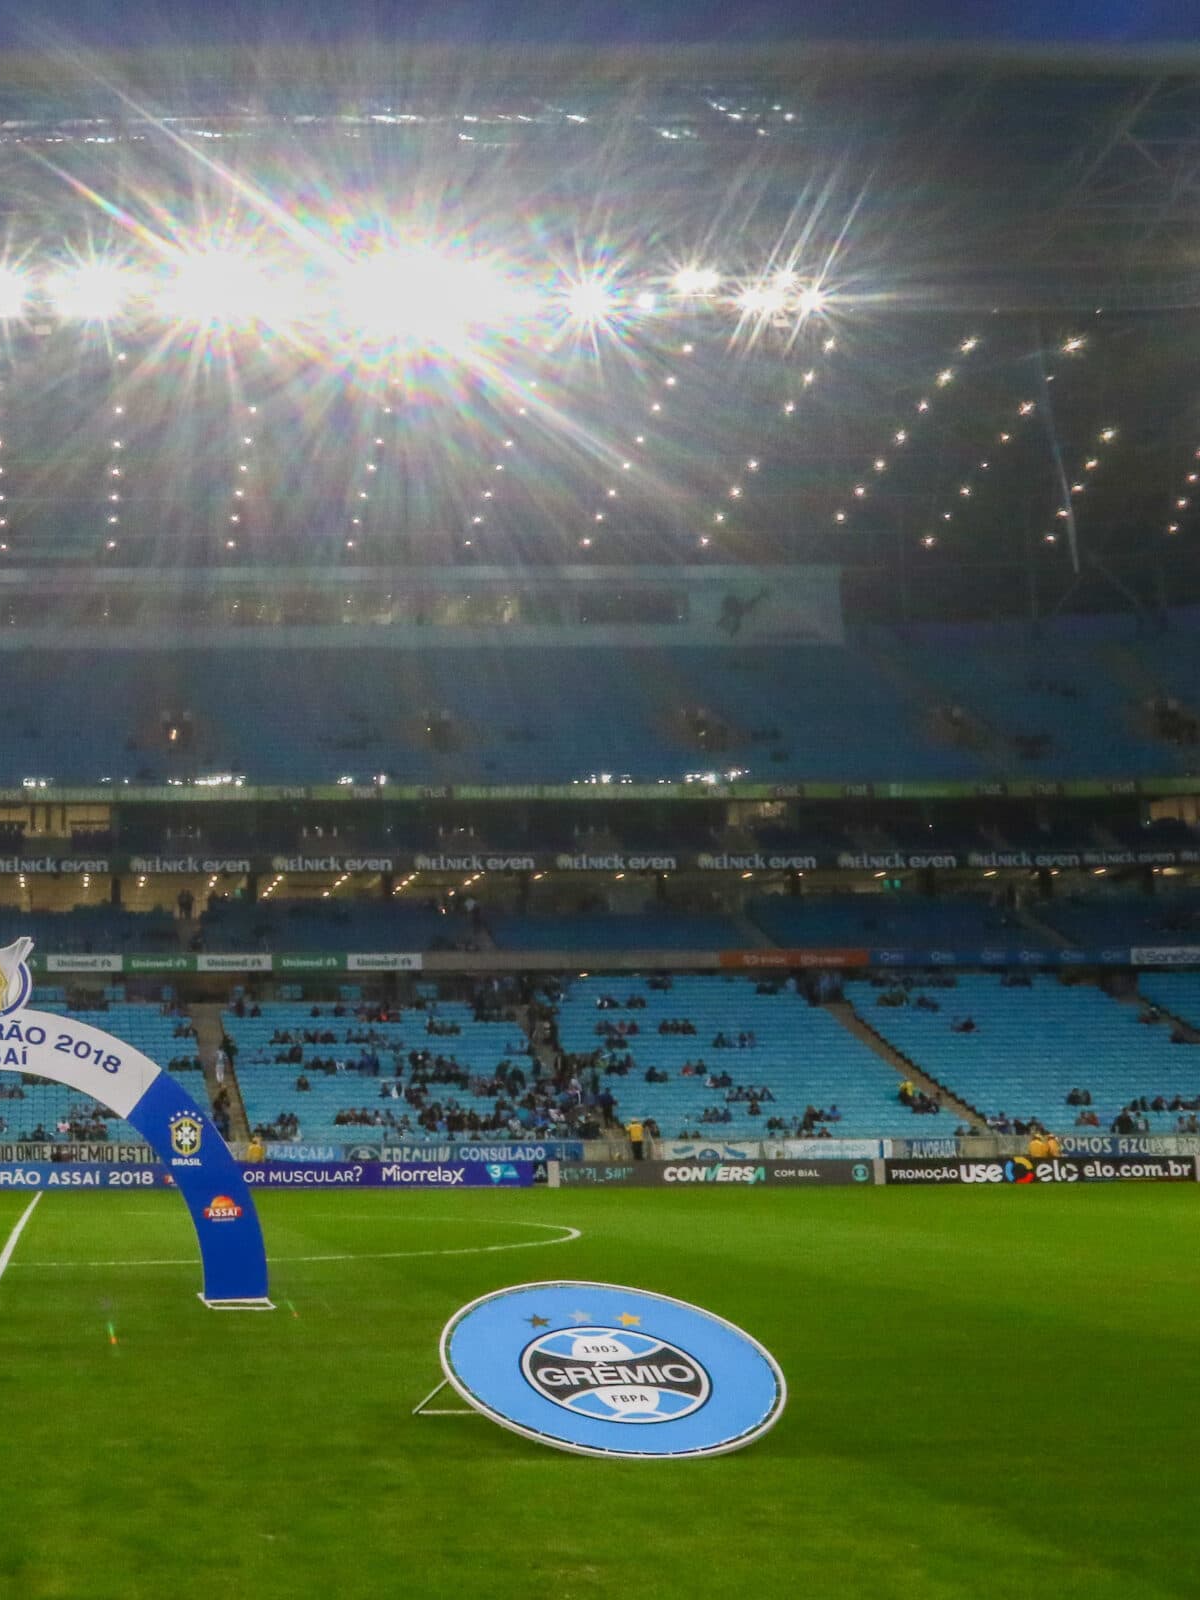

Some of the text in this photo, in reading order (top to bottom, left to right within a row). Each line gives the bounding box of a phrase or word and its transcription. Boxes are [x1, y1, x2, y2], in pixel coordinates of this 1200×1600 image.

[61, 859, 108, 873] even
[129, 856, 249, 873] MELNICK even
[272, 856, 392, 871] MELNICK even
[414, 855, 535, 870] MELNICK even
[556, 854, 676, 870] MELNICK even
[698, 854, 816, 869] MELNICK even
[908, 855, 956, 869] even
[1035, 855, 1079, 867] even
[54, 1034, 122, 1074] 2018
[460, 1146, 546, 1162] CONSULADO
[171, 1157, 202, 1167] BRASIL
[1083, 1160, 1192, 1177] elo.com.br
[109, 1171, 154, 1185] 2018
[269, 1166, 363, 1183] MUSCULAR?
[382, 1164, 465, 1184] Miorrelax
[664, 1163, 766, 1184] CONVERSA
[774, 1169, 796, 1178] COM
[891, 1166, 958, 1180] PROMOÇÃO
[583, 1344, 619, 1354] 1903
[536, 1361, 696, 1388] GRÊMIO
[611, 1394, 651, 1404] FBPA
